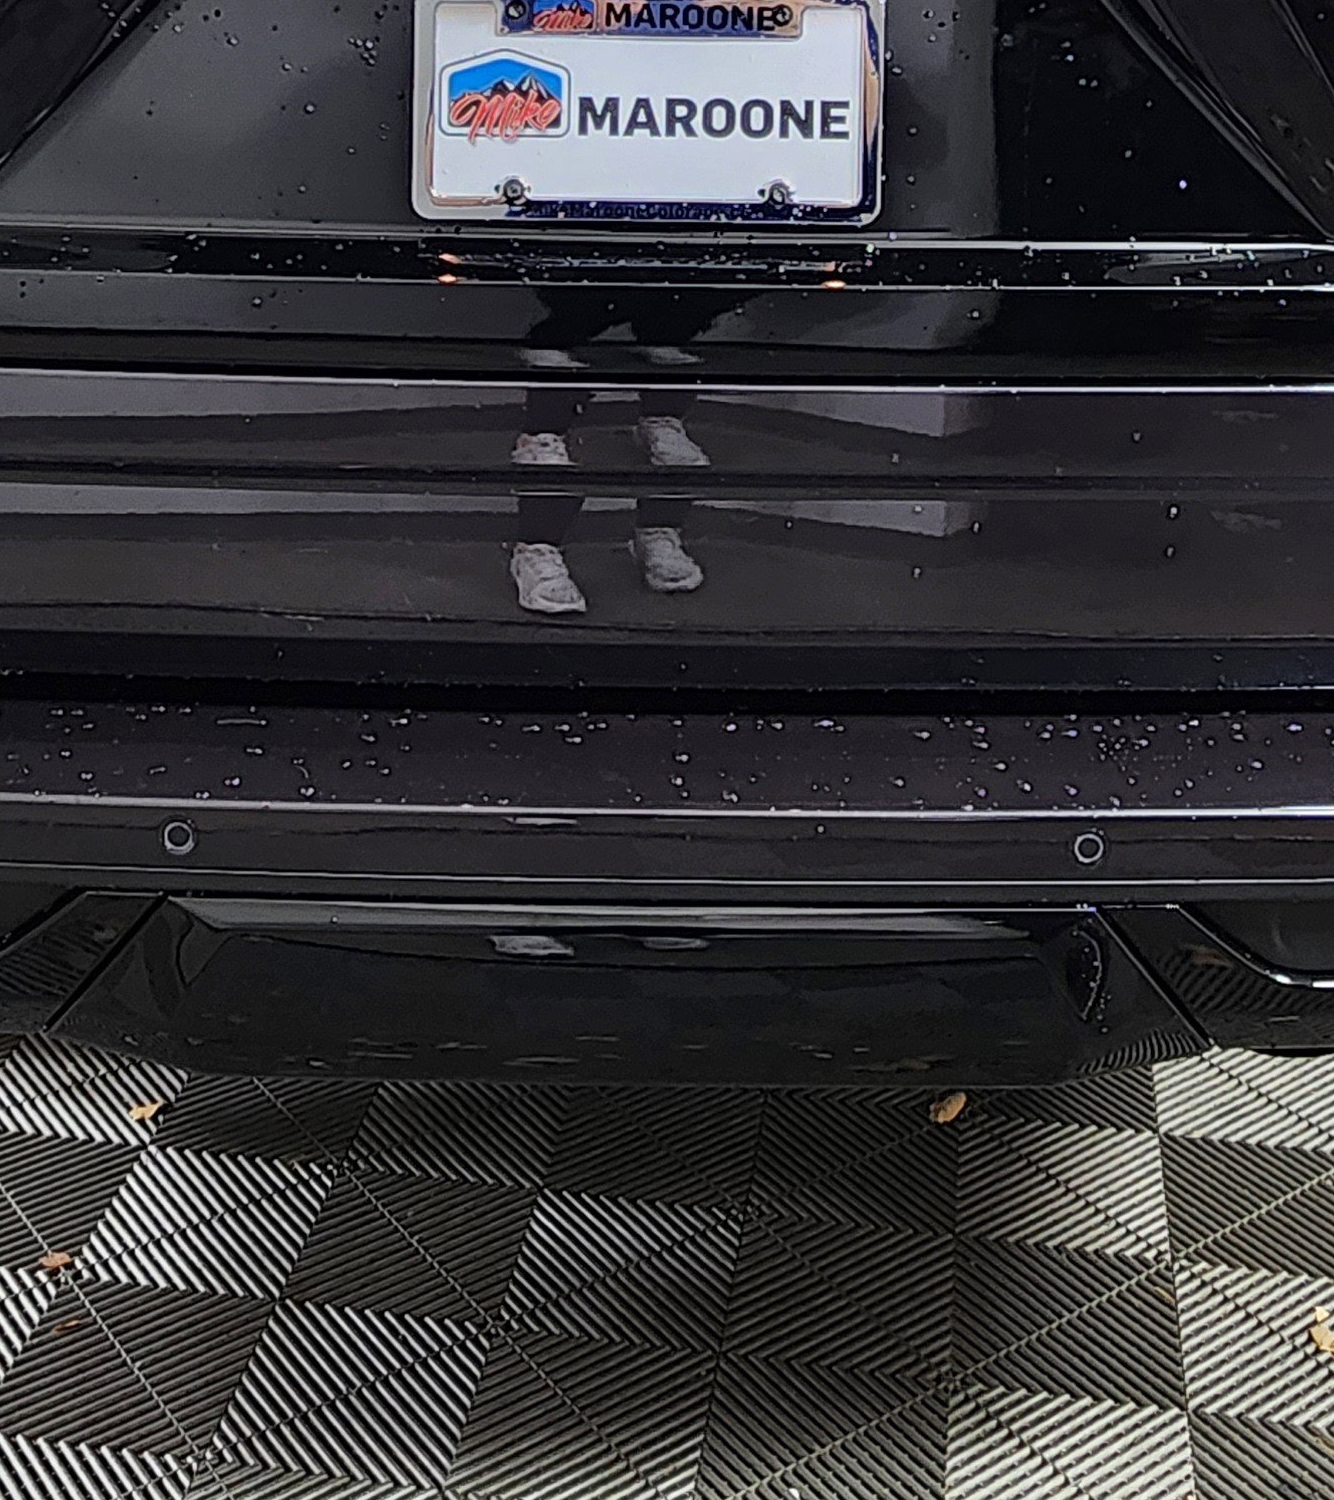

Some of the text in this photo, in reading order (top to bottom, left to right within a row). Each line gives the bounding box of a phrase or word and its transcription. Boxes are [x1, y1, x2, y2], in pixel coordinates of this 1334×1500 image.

[604, 2, 777, 32] MAROONE
[450, 89, 851, 143] Mike MAROONE
